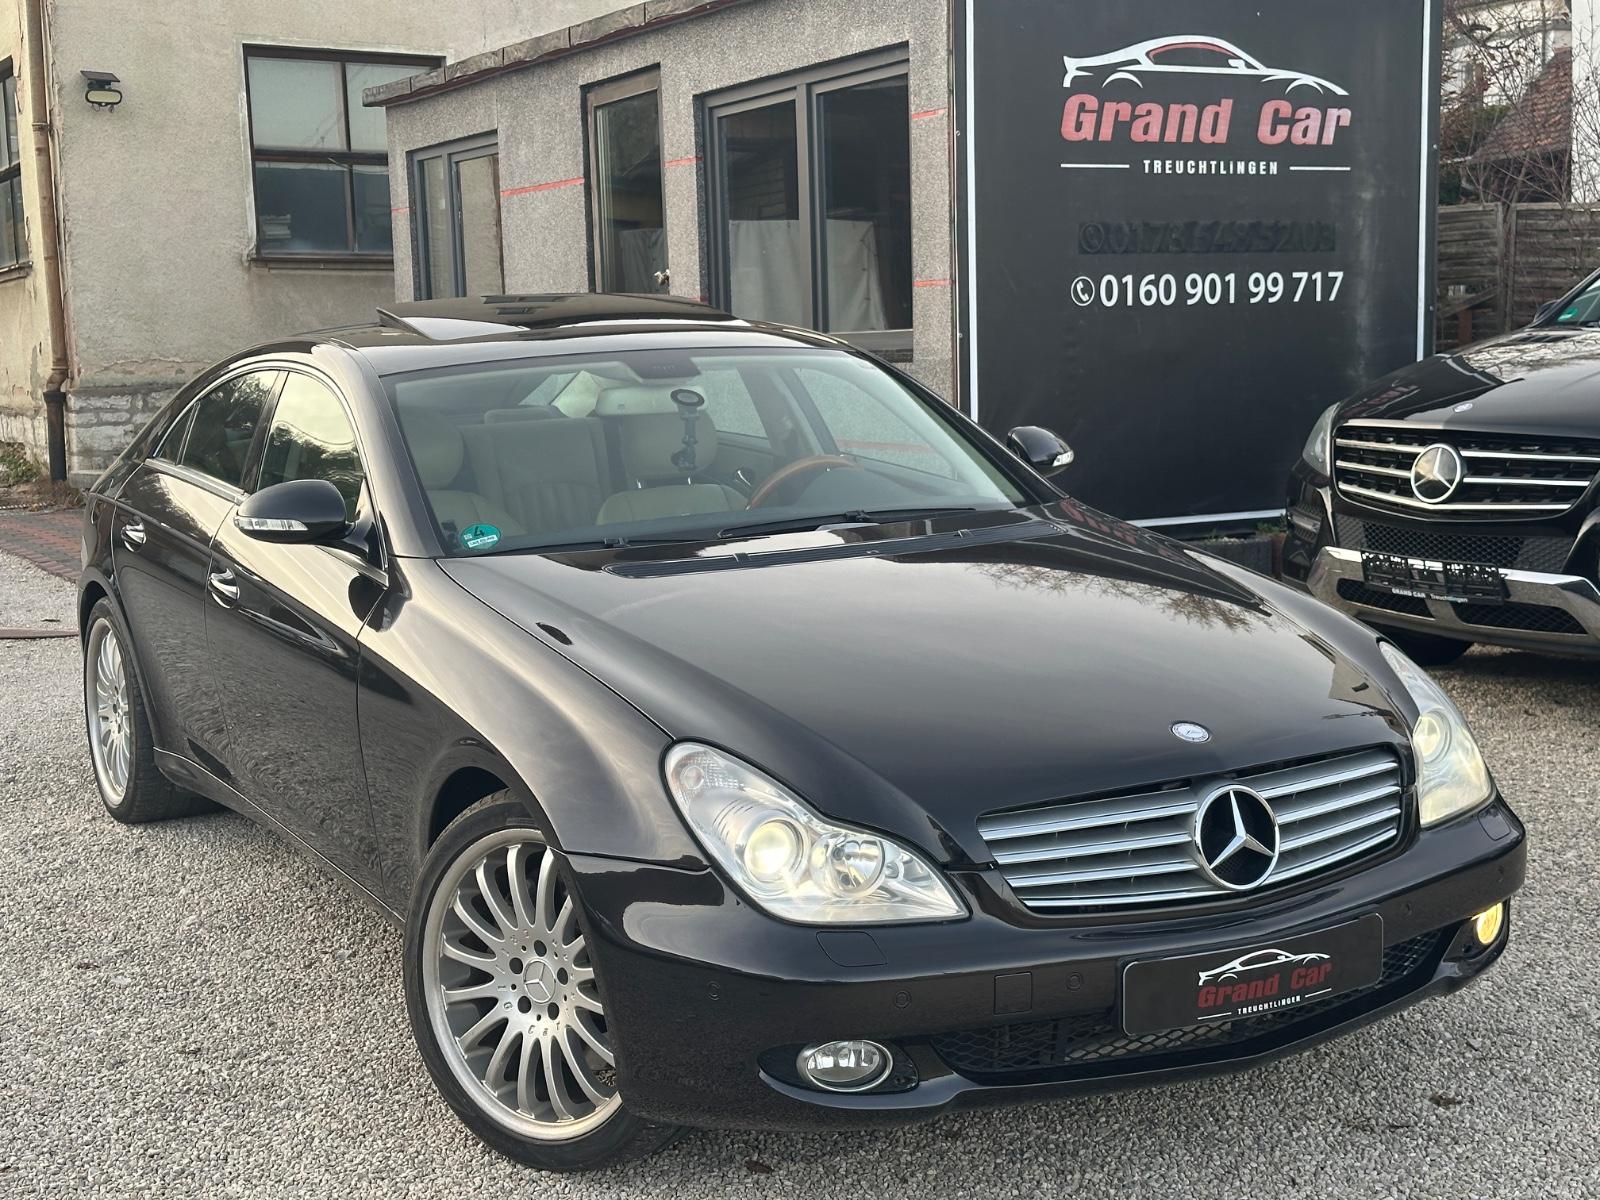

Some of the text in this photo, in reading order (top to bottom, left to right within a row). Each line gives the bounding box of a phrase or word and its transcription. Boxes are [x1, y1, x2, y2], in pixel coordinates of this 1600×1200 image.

[1061, 93, 1352, 145] Grand Car
[1143, 159, 1278, 175] TREUCHTLINGEN
[1100, 271, 1344, 307] 0160 901 99 717
[1198, 962, 1333, 1008] Grand Car
[1237, 995, 1301, 1015] TREUCHTLINGEN
